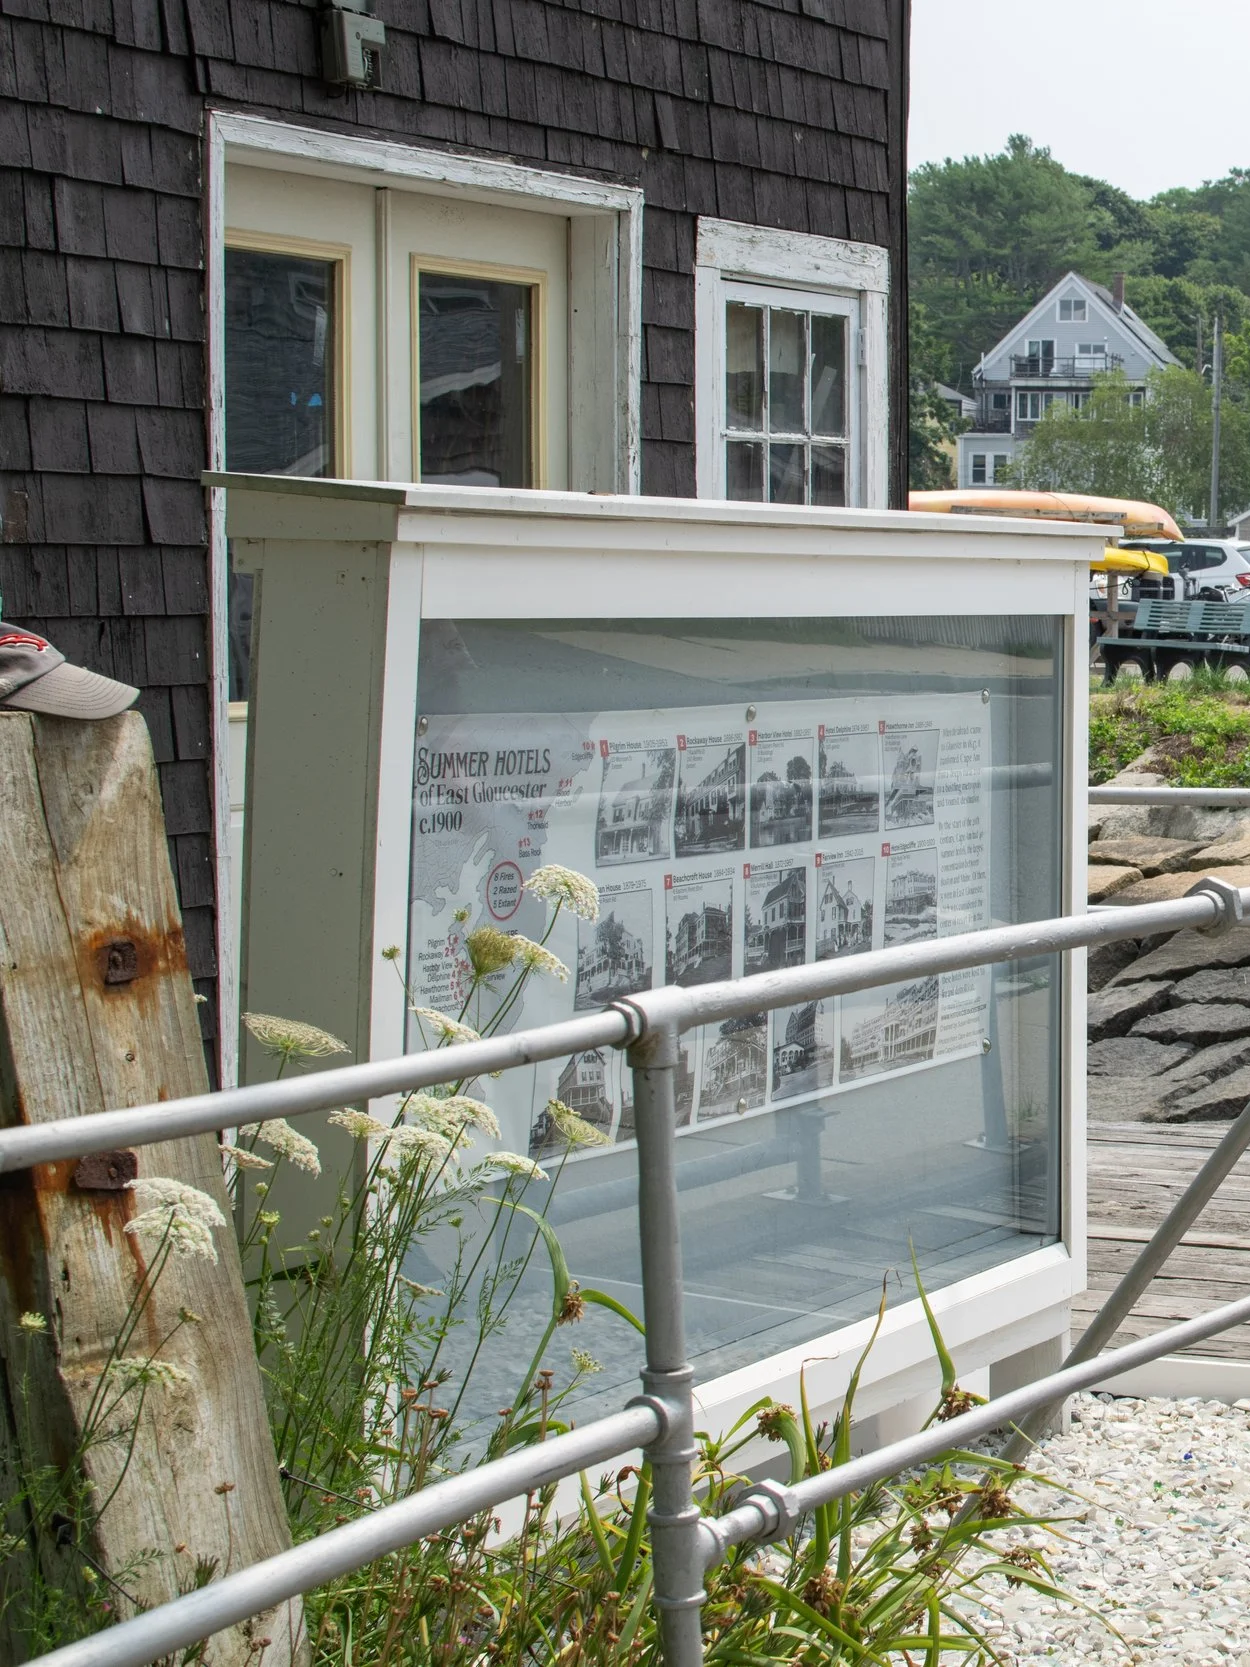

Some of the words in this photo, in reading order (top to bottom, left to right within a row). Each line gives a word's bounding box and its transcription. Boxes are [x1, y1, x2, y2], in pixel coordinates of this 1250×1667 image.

[825, 726, 836, 734] Hotel
[886, 722, 908, 731] Hawthorne
[687, 735, 708, 745] Rockaway
[708, 735, 722, 743] House
[757, 732, 772, 740] Harbor
[773, 731, 783, 739] View
[783, 730, 793, 738] Hotel
[609, 742, 626, 752] Pilgrim
[627, 741, 642, 750] House
[417, 747, 490, 785] SUMMER
[494, 749, 551, 776] HOTELS
[420, 784, 434, 807] of
[437, 784, 469, 805] East
[473, 781, 547, 803] Gloucester
[536, 809, 543, 819] 12
[419, 810, 462, 834] c.1900
[523, 838, 530, 846] 13
[519, 849, 530, 858] Bass
[822, 852, 836, 863] Fairview
[494, 872, 499, 881] 8
[500, 872, 514, 881] Fires
[673, 872, 698, 884] Beachcroft
[699, 872, 713, 881] House
[493, 886, 498, 895] 2
[499, 885, 517, 894] Razed
[606, 883, 622, 892] House
[493, 900, 498, 908] 5
[498, 899, 517, 908] Extant
[427, 939, 445, 949] Pilgrim
[418, 951, 444, 961] Rockaway
[444, 947, 450, 957] 2
[441, 961, 453, 970] View
[454, 958, 459, 968] 3
[428, 972, 451, 982] Delphine
[420, 983, 449, 995] Hawthorne
